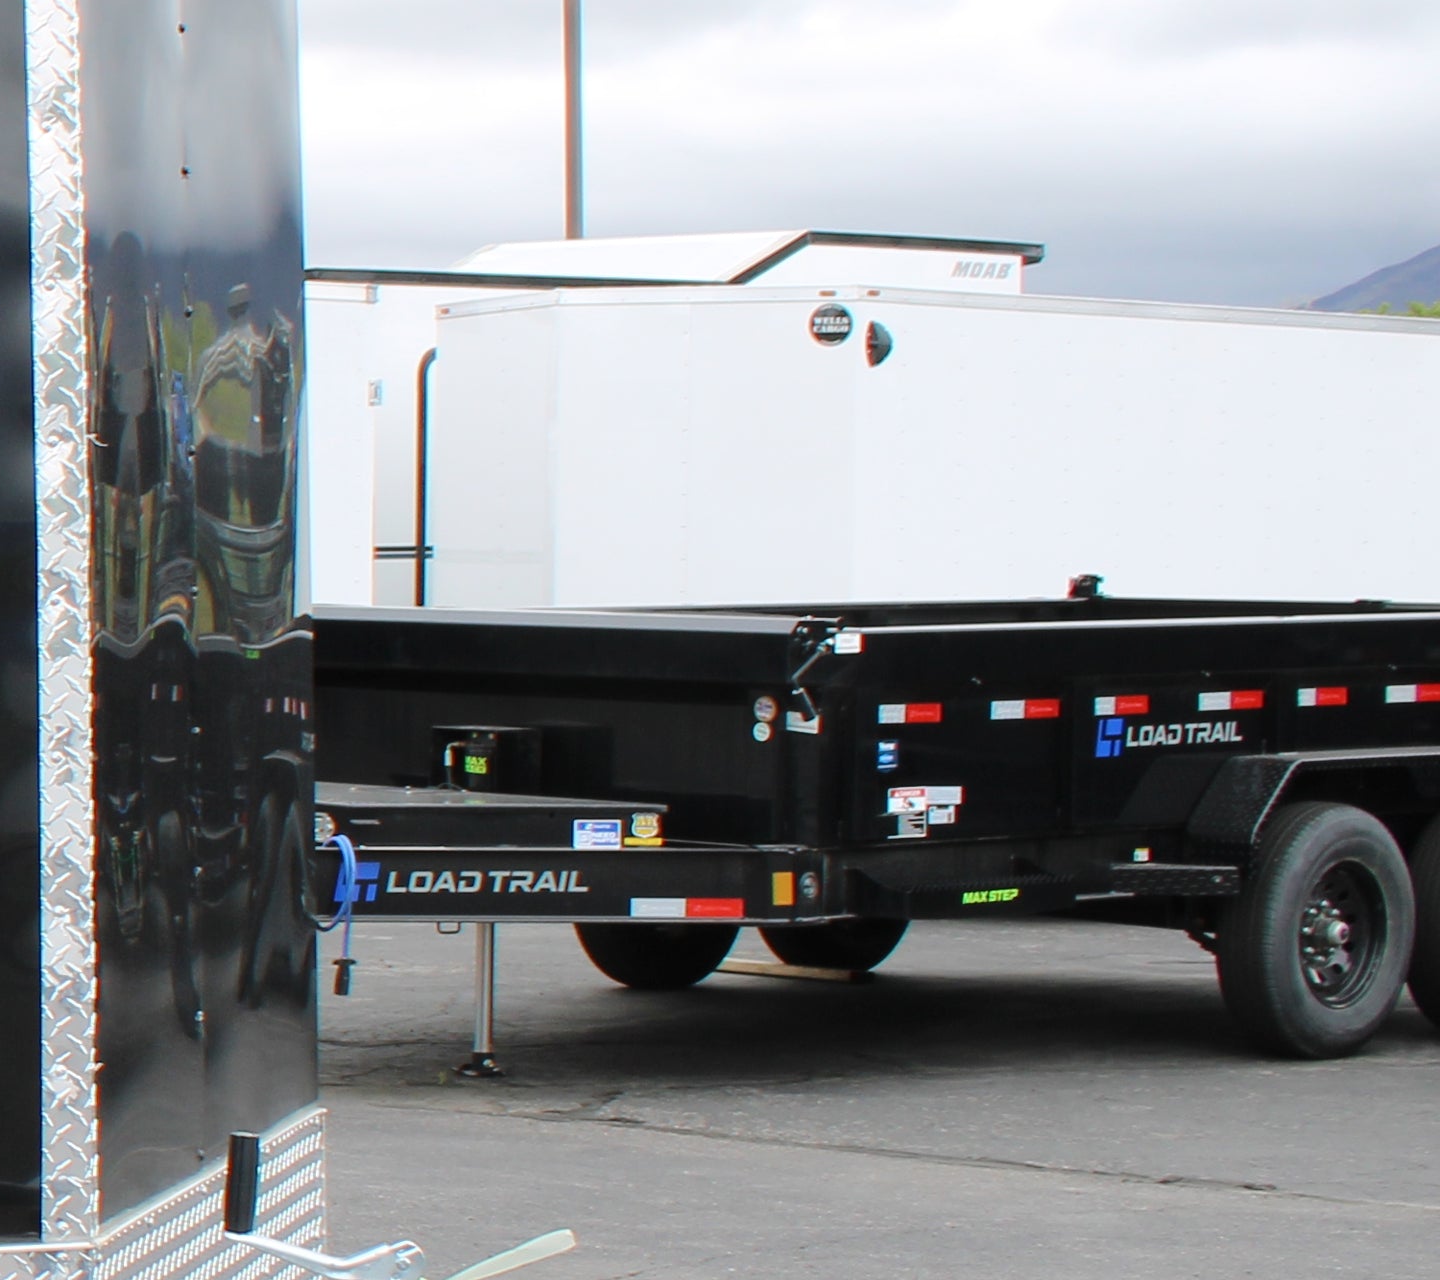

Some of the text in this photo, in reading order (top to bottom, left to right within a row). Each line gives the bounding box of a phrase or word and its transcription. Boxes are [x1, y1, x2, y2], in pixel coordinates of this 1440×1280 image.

[951, 261, 1013, 279] MOAB
[1125, 724, 1182, 747] LOAD
[1184, 720, 1244, 744] TRAIL
[386, 870, 484, 893] LOAD
[487, 870, 590, 893] TRAIL
[963, 888, 1019, 904] MAX STEP
